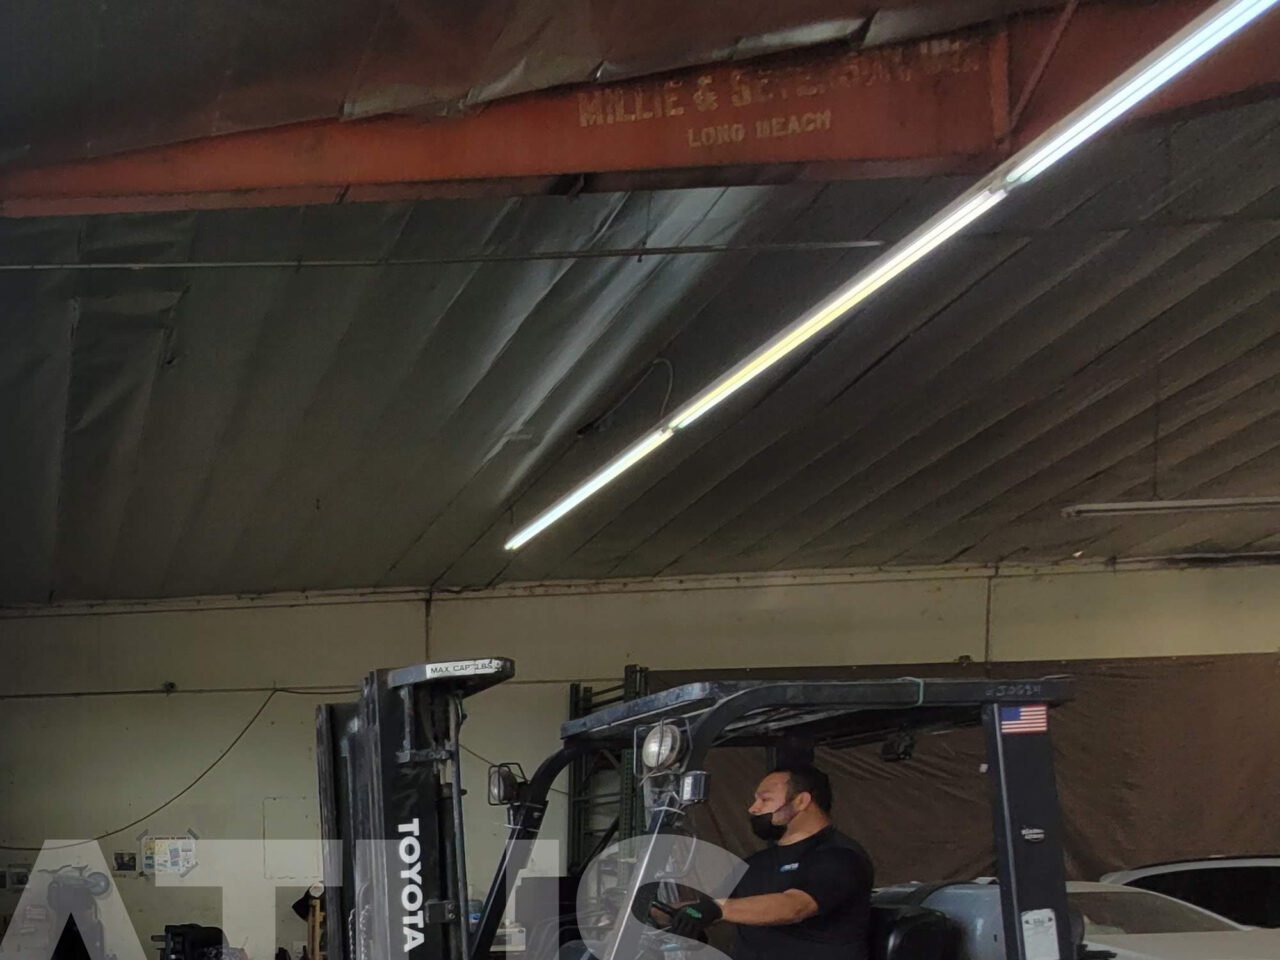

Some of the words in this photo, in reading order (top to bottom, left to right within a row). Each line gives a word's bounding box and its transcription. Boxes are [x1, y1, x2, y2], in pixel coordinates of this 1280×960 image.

[687, 123, 745, 148] LONG
[431, 666, 450, 674] MAX
[398, 818, 425, 952] TOYOTA
